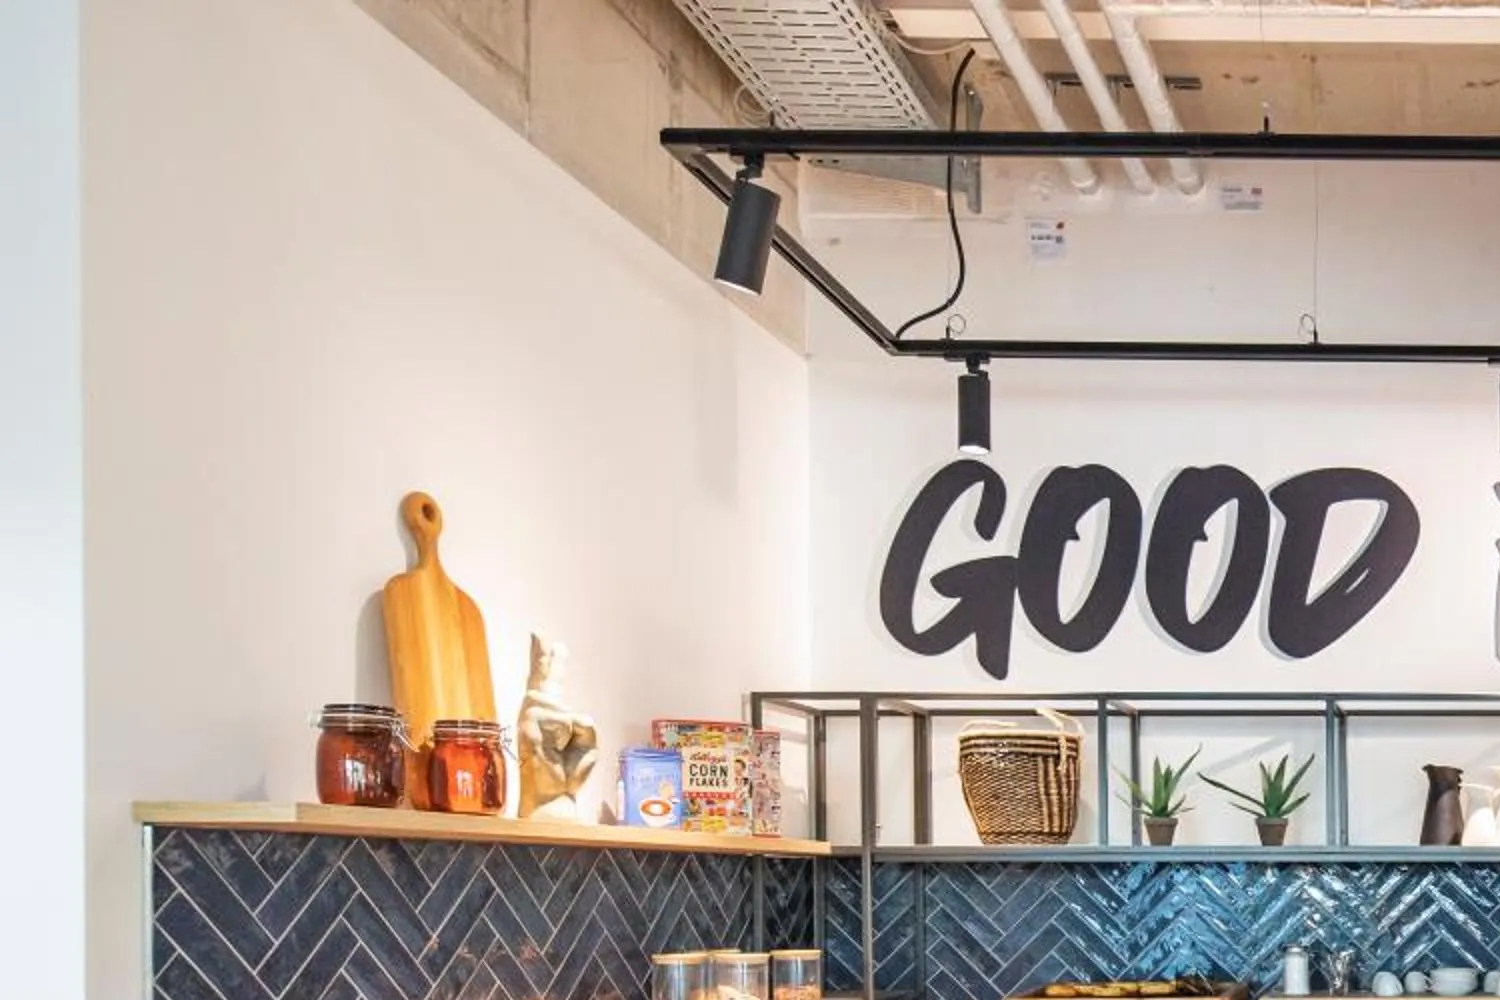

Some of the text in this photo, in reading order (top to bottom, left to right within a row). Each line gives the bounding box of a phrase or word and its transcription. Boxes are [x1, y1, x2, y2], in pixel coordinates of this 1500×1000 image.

[879, 459, 1421, 681] GOOD
[689, 763, 729, 777] CORN
[689, 777, 729, 788] FLAKES
